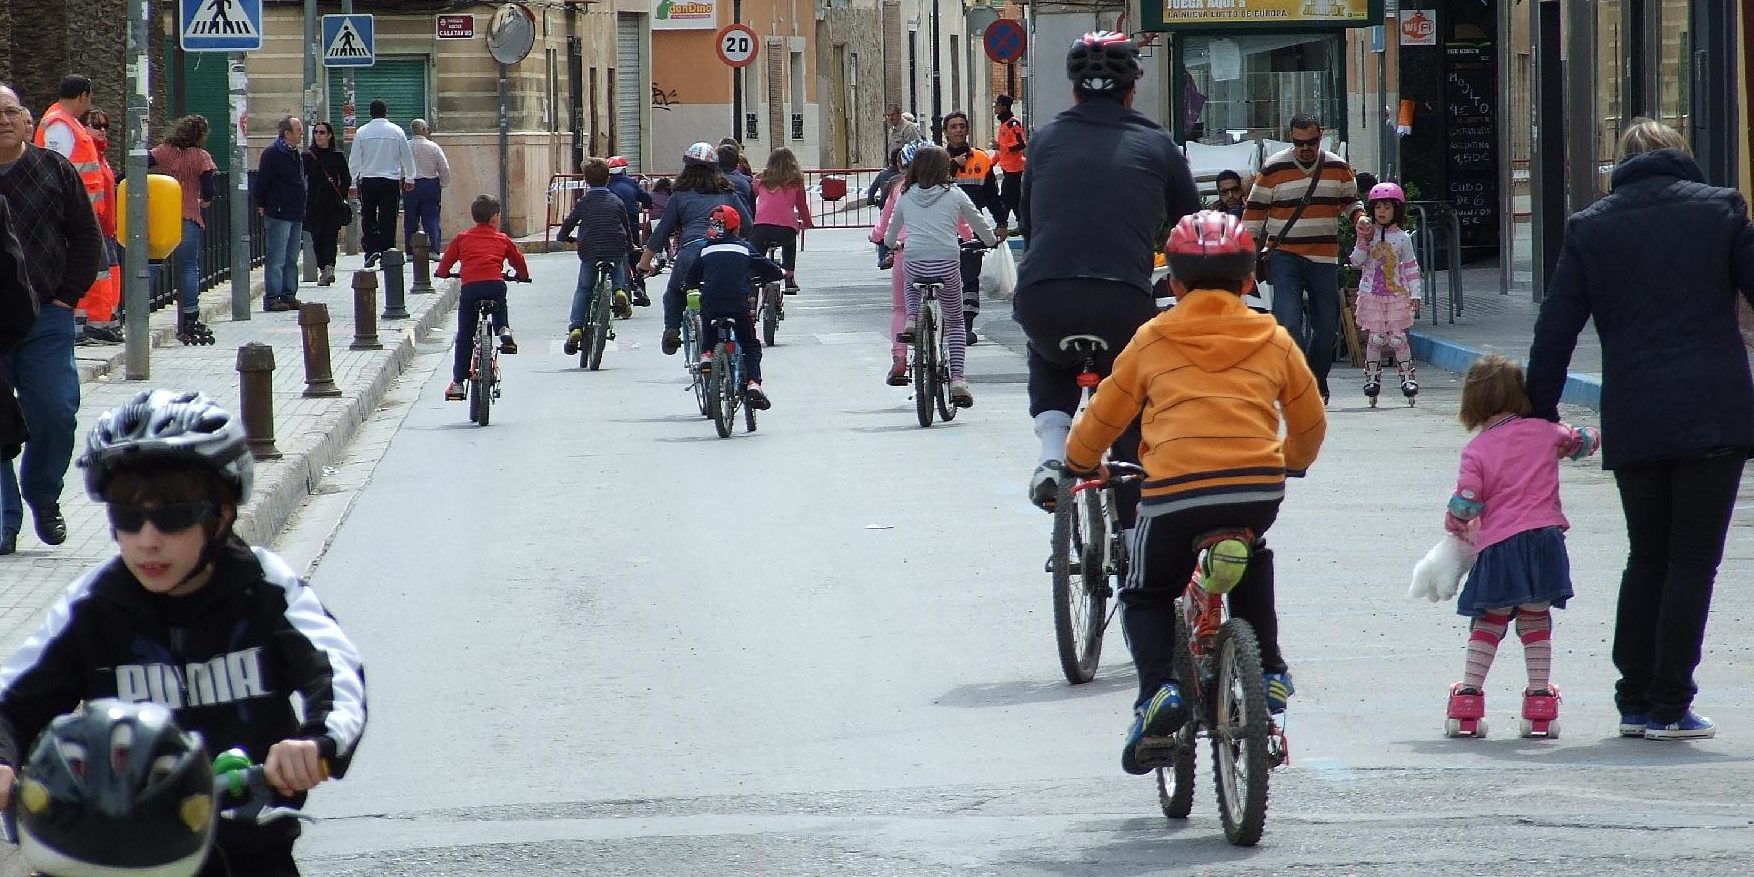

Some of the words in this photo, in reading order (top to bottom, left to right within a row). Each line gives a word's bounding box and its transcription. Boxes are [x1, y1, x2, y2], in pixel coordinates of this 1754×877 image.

[1168, 11, 1178, 19] LA
[1254, 9, 1287, 18] EUROPA
[726, 37, 749, 53] 20
[1449, 73, 1489, 114] MOJITO
[115, 647, 265, 709] PUMA
